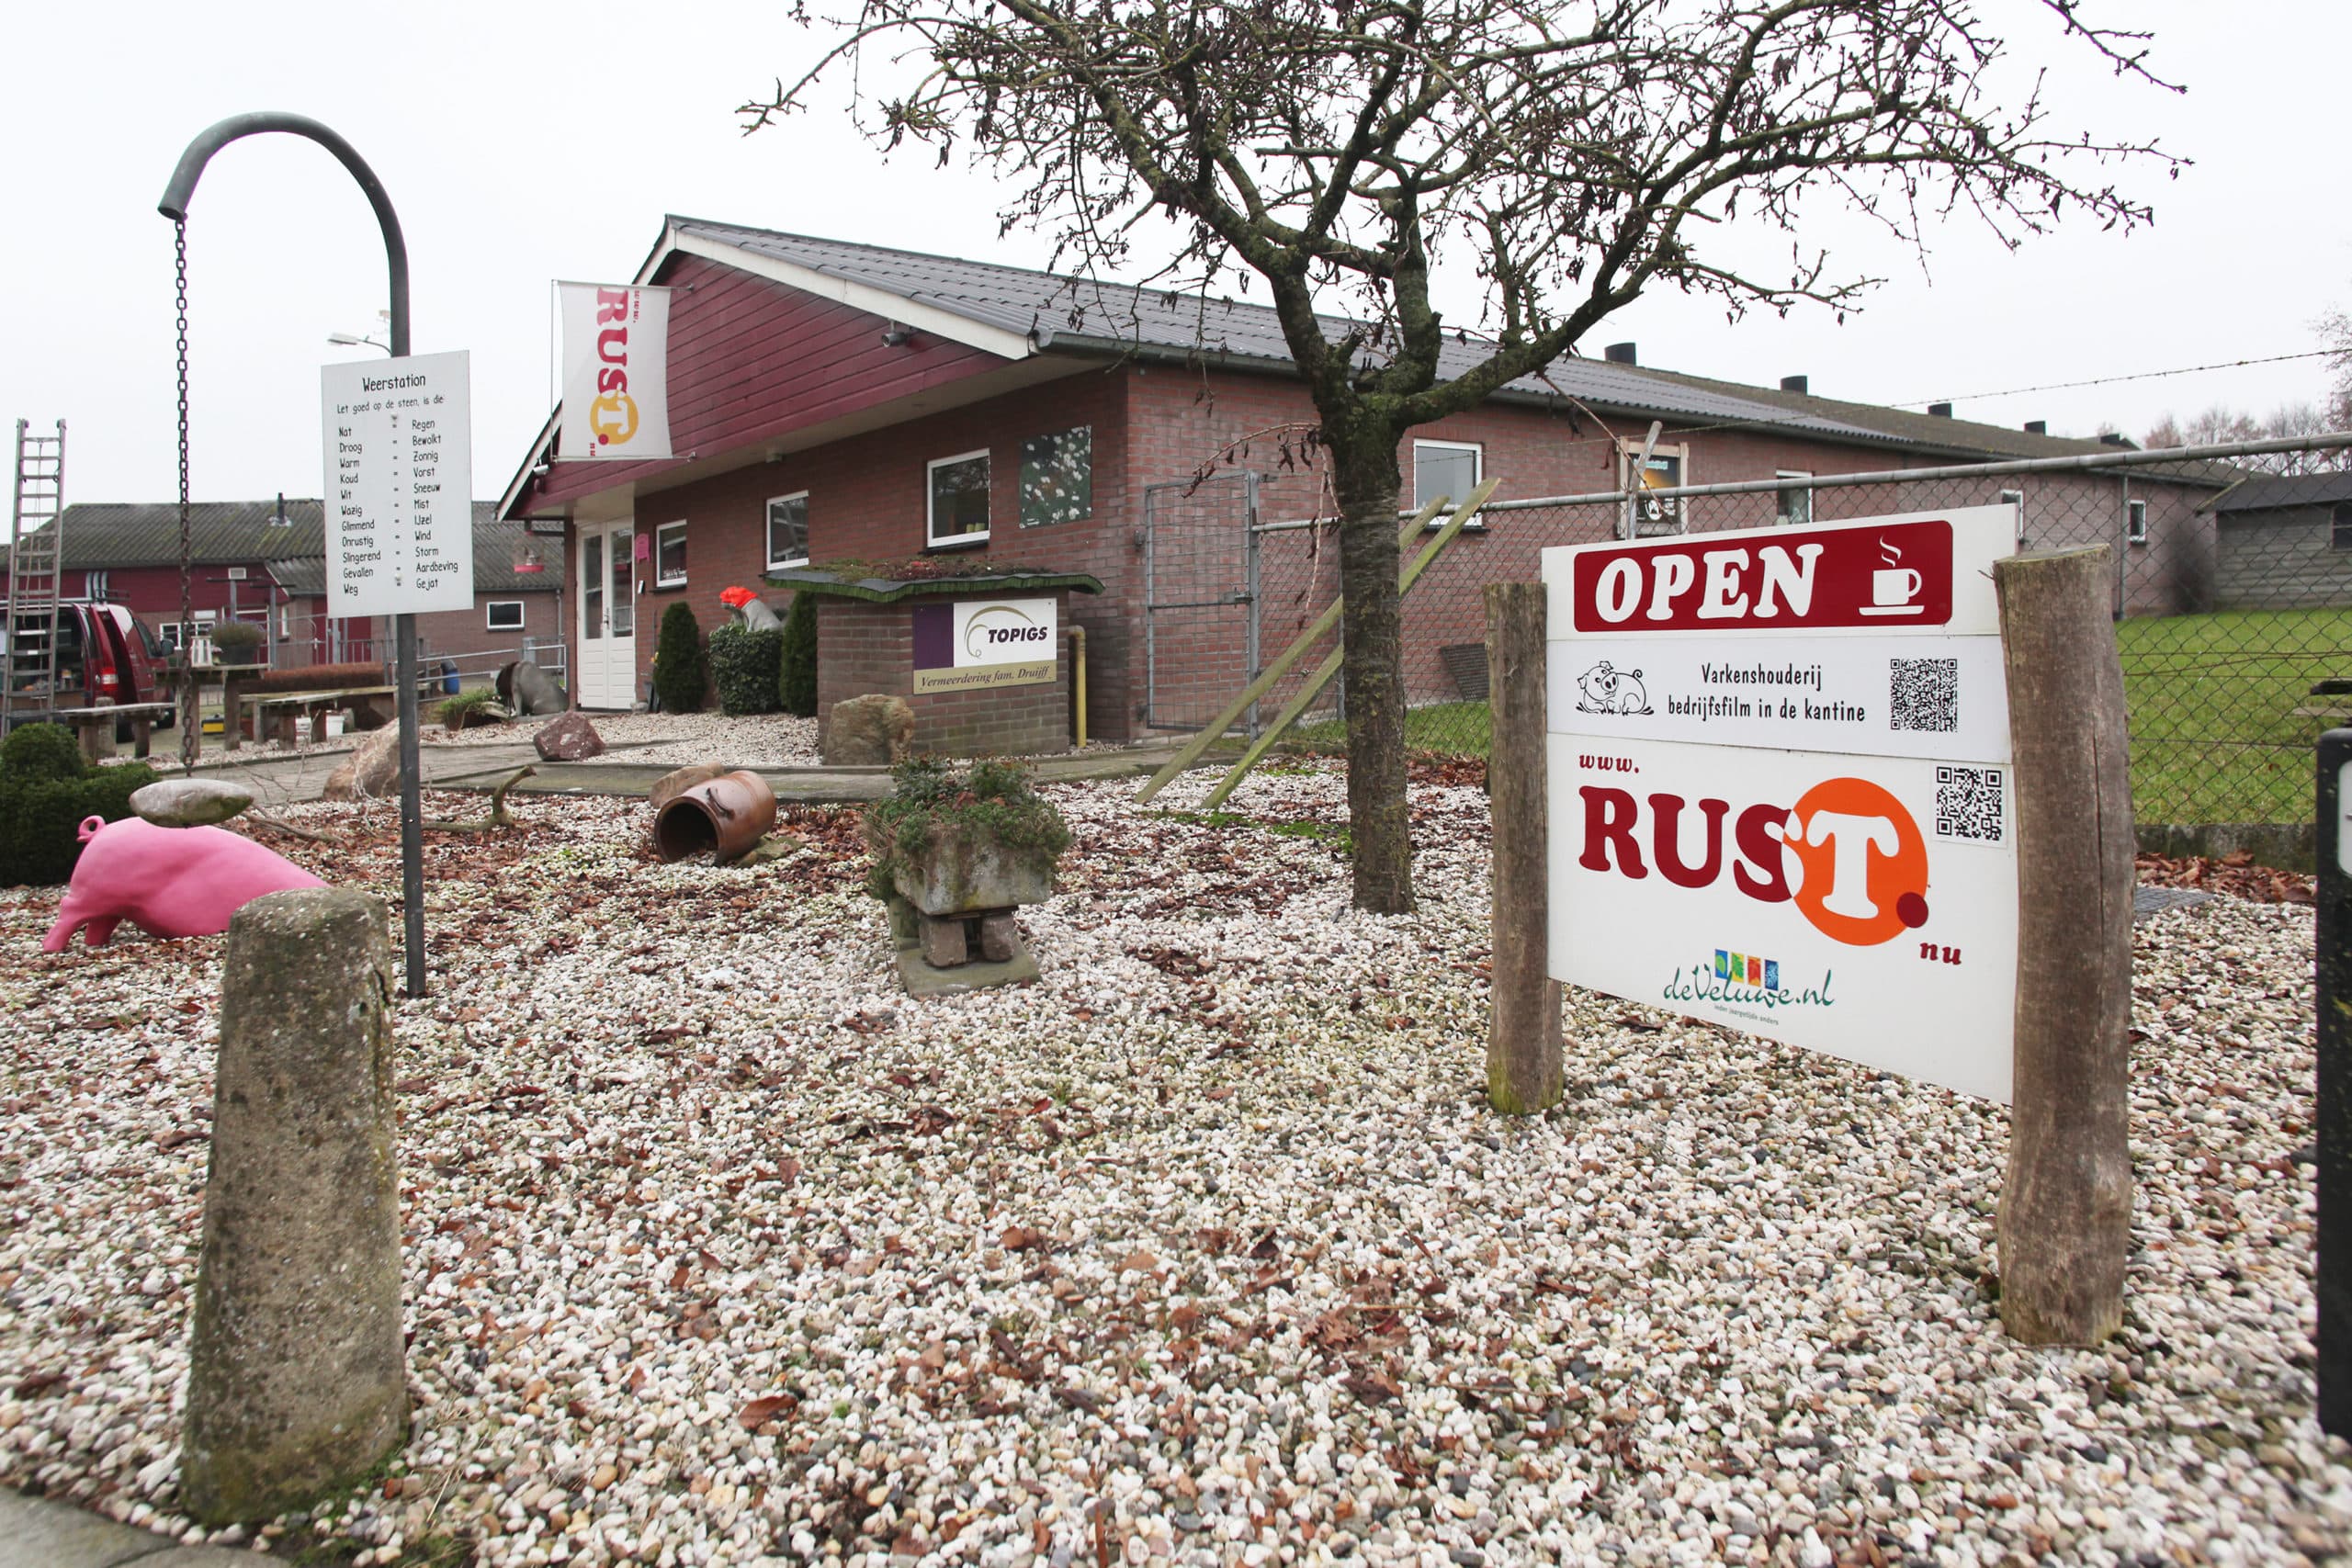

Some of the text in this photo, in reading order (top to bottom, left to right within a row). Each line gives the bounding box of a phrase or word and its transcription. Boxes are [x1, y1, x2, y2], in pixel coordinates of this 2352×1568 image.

[361, 373, 426, 393] Weerstation
[336, 403, 349, 414] Let
[352, 400, 370, 415] goed
[372, 401, 382, 412] op
[385, 399, 395, 410] de
[423, 396, 430, 405] is
[433, 393, 445, 404] die
[338, 419, 435, 438] Nat Regen
[338, 433, 442, 455] Droog Bewolkt
[338, 449, 439, 469] Warm Zonnig
[339, 466, 435, 485] Koud Vorst
[340, 481, 441, 501] Wit Sneeuw
[340, 498, 430, 518] Wazig Mist
[341, 513, 433, 532] Glimmend IJzel
[341, 529, 432, 549] Onrustig Wind
[342, 546, 439, 565] Slingerend Storm
[343, 560, 459, 580] Gevallen Aardbeving
[343, 577, 439, 597] Weg Gejat
[1595, 543, 1824, 623] OPEN
[989, 626, 1048, 643] TOPIGS
[922, 671, 992, 687] Vermeerdering
[993, 671, 1014, 682] fam.
[1702, 662, 1822, 692] Varkenshouderij
[1668, 694, 1866, 721] bedrijfsfilm in de kantine
[1578, 753, 1640, 773] www.
[1919, 942, 1962, 965] nu
